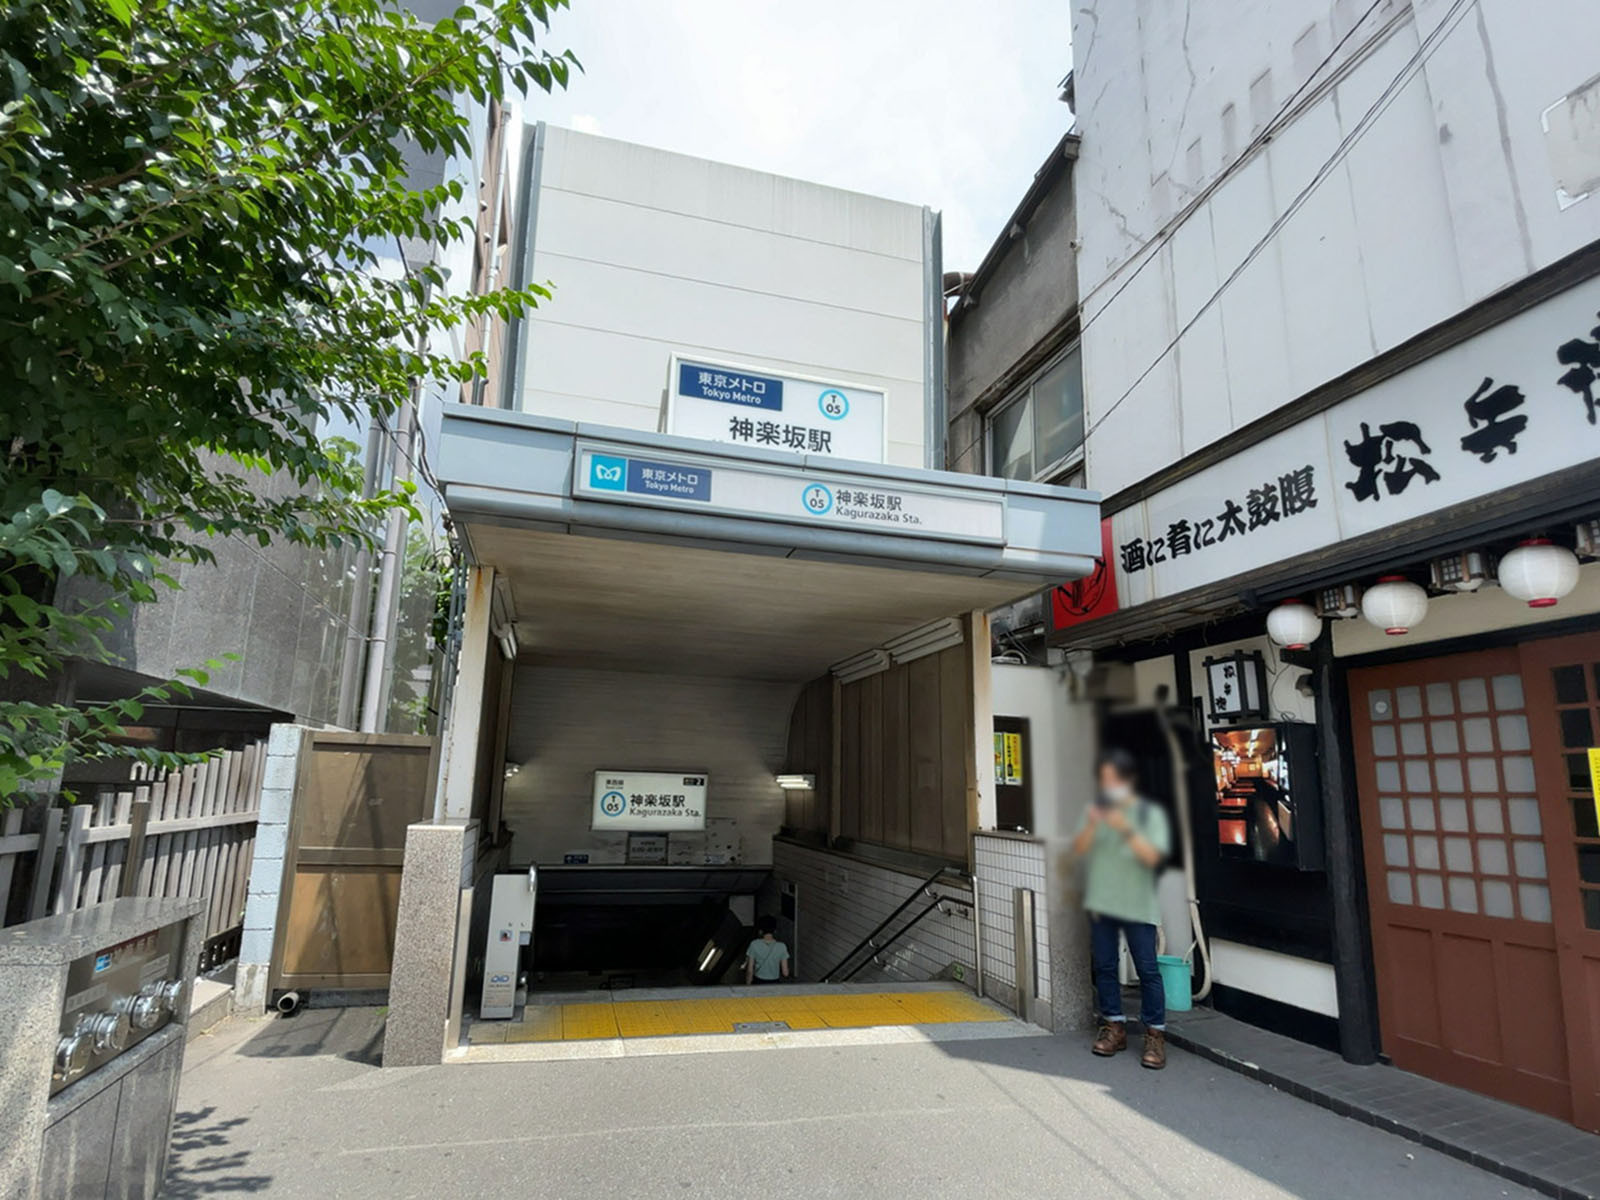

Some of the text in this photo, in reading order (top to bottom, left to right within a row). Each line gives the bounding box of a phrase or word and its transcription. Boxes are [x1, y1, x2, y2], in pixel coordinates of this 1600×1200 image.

[698, 372, 766, 394] 東京メトロ
[702, 386, 762, 405] Tokyo Metro
[830, 395, 837, 403] T
[826, 404, 841, 415] 05
[729, 416, 832, 454] 神楽坂駅
[642, 468, 698, 485] 東京メトロ
[645, 480, 695, 494] Tokyo Metro
[814, 489, 820, 498] T
[809, 498, 825, 509] 05
[836, 489, 902, 512] 神楽坂駅
[836, 506, 922, 525] Kagurazaka Sta.
[1120, 464, 1319, 574] 酒に肴に太鼓腹
[630, 793, 686, 808] 神楽坂駅
[630, 808, 702, 818] Kagurazaka Sta.
